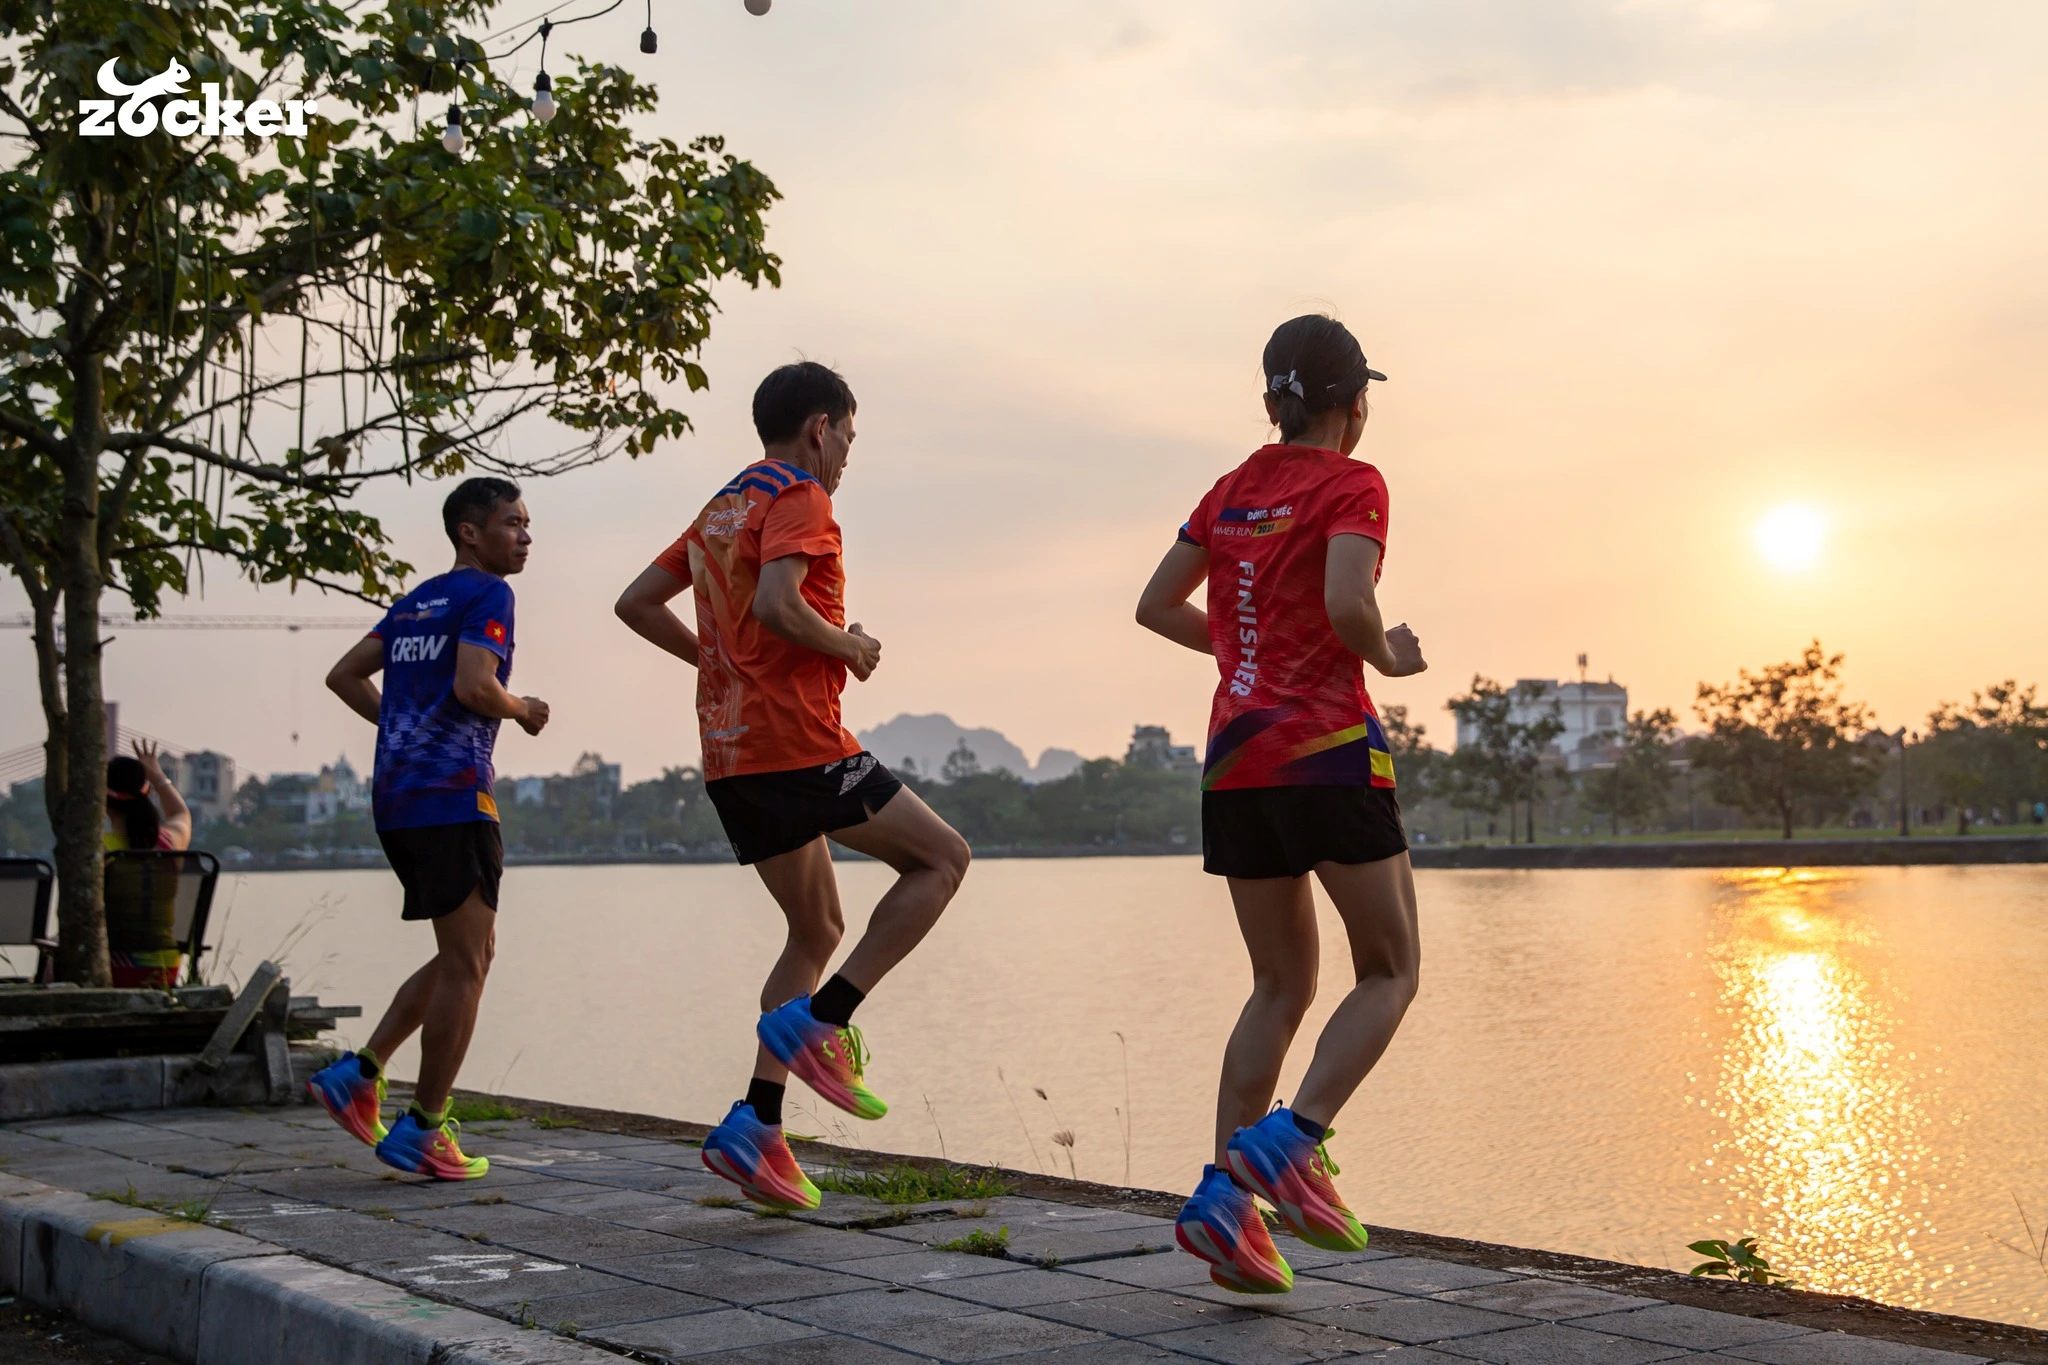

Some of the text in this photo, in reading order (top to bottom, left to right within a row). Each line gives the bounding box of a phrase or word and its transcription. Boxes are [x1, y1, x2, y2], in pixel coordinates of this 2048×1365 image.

[1235, 526, 1254, 537] RUN
[1229, 560, 1258, 697] FINISHER
[391, 634, 449, 664] CREW
